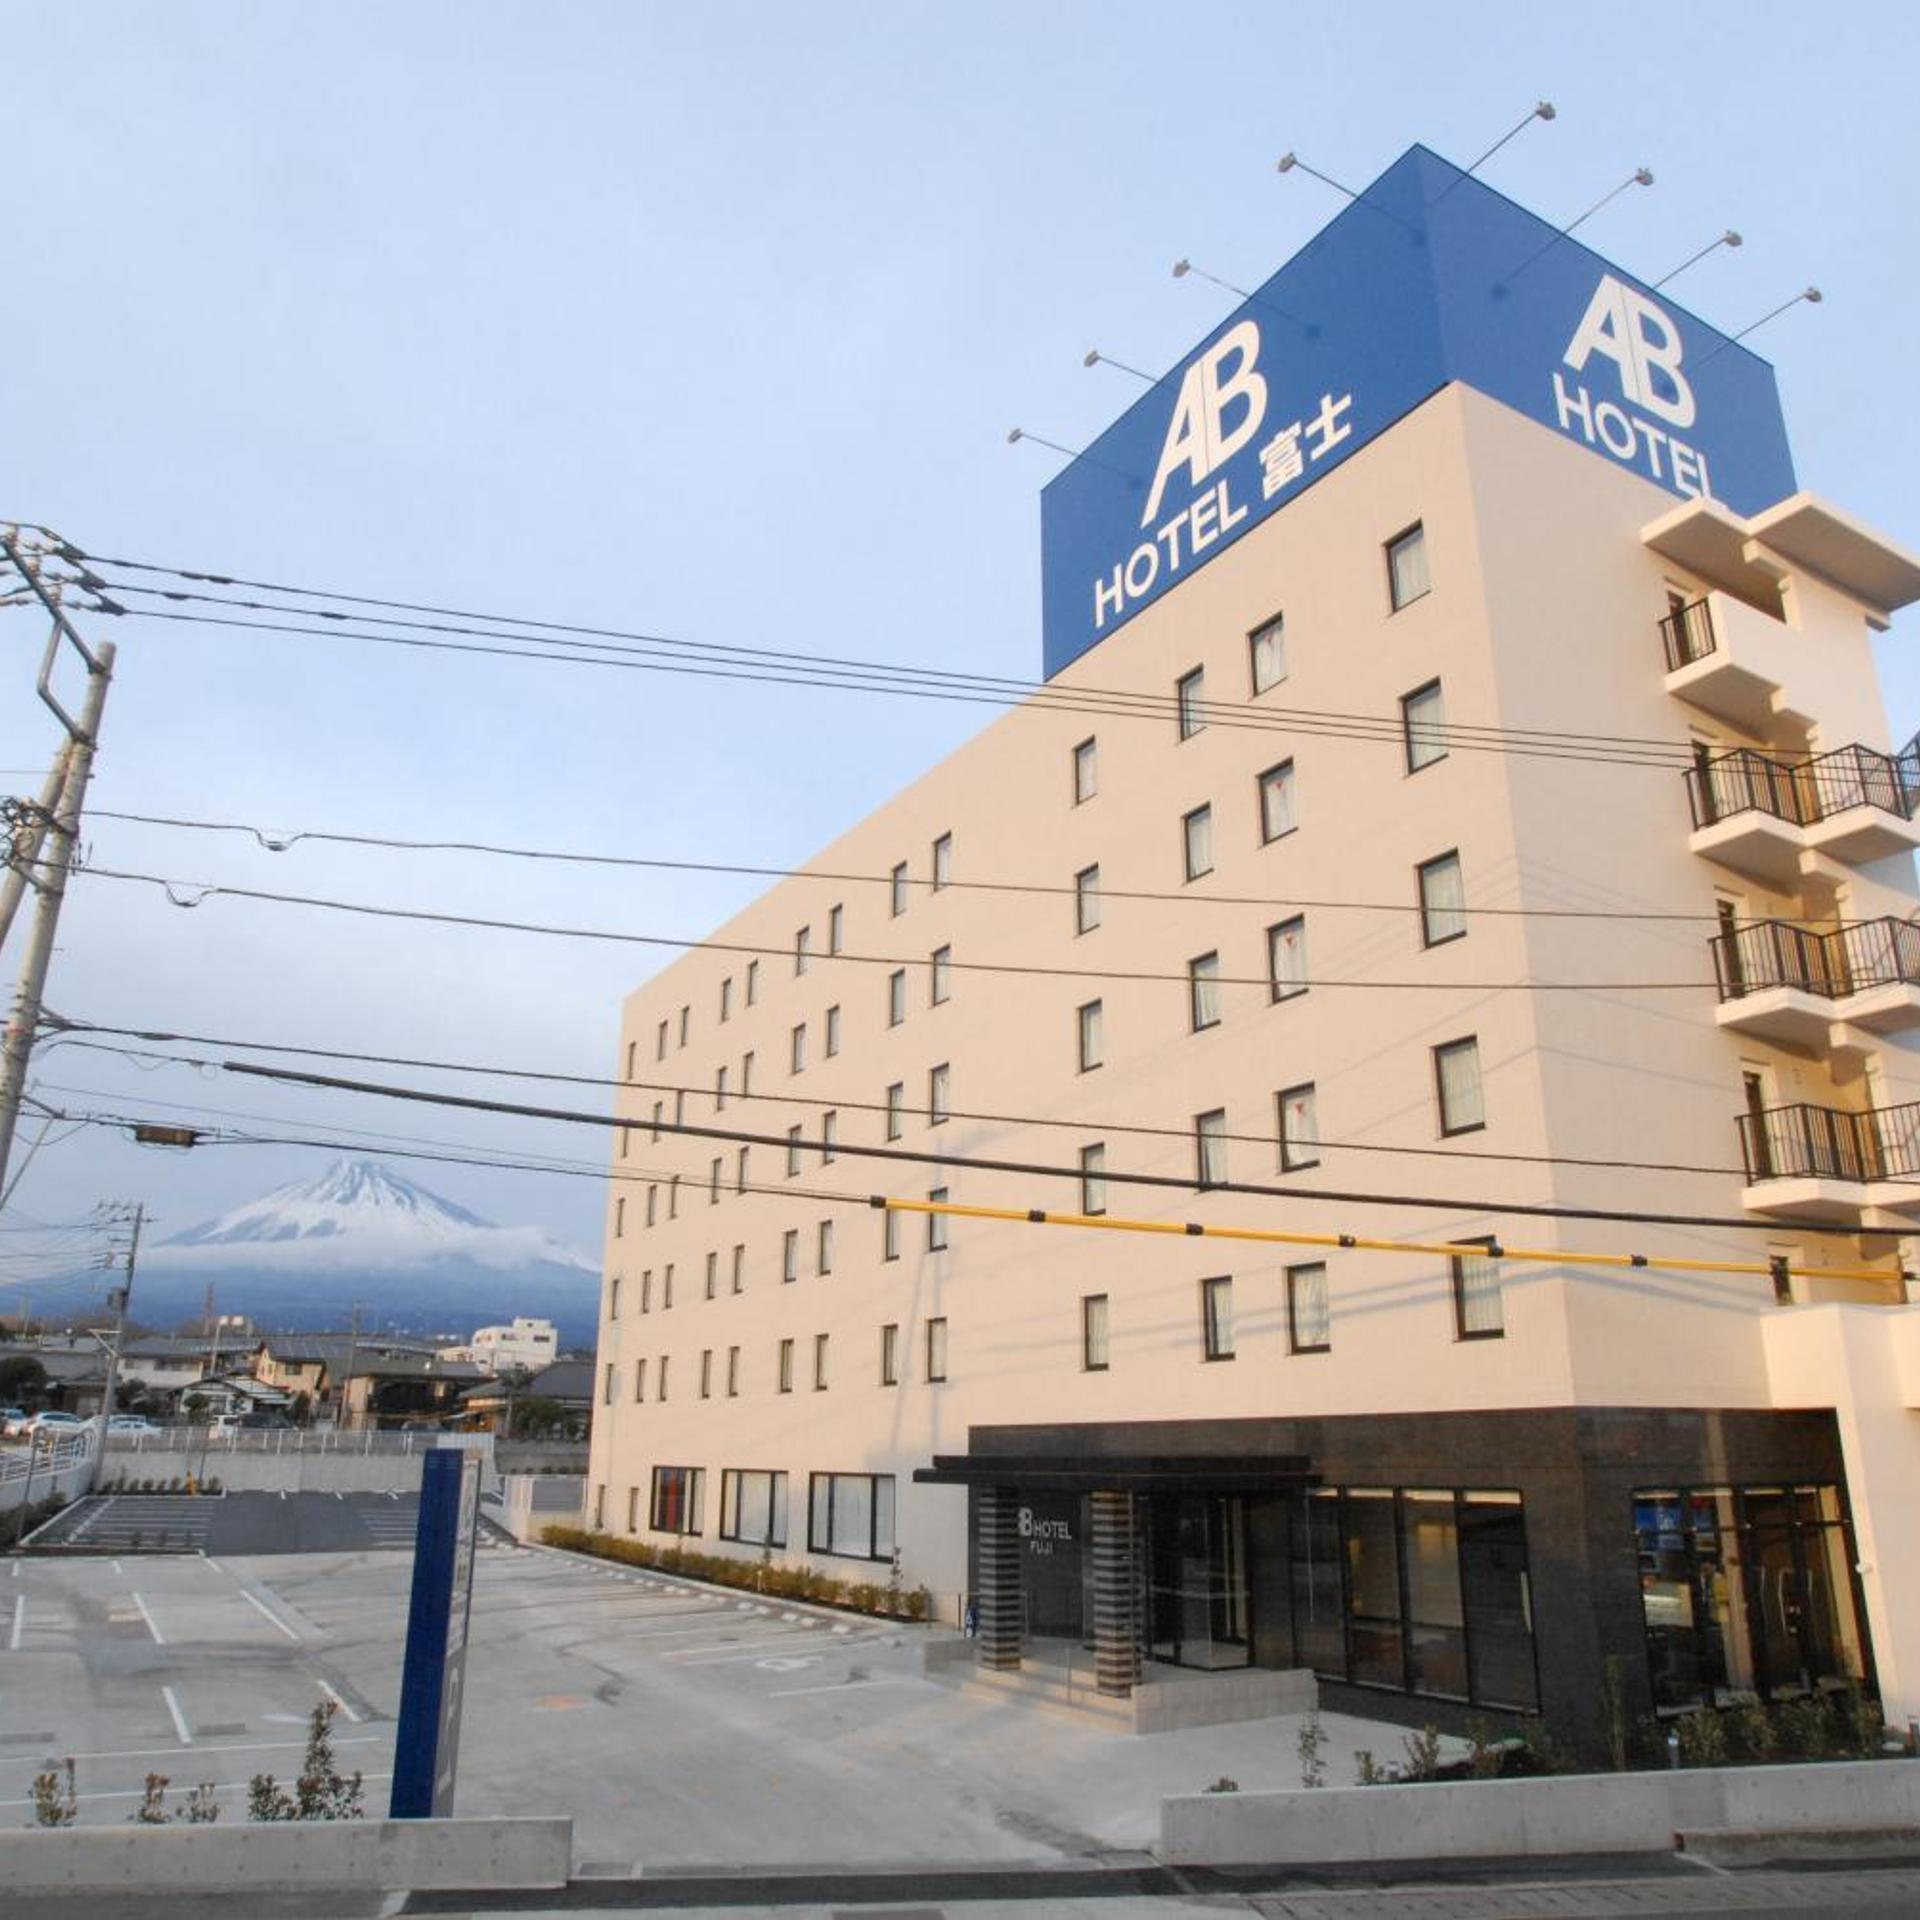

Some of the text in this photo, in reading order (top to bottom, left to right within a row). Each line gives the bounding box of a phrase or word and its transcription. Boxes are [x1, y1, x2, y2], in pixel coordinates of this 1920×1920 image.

[1140, 320, 1268, 529] AB
[1562, 273, 1697, 429] AB
[1094, 393, 1352, 628] HOTEL 富士
[1029, 1541, 1053, 1555] FUJI
[1033, 1519, 1072, 1540] HOTEL
